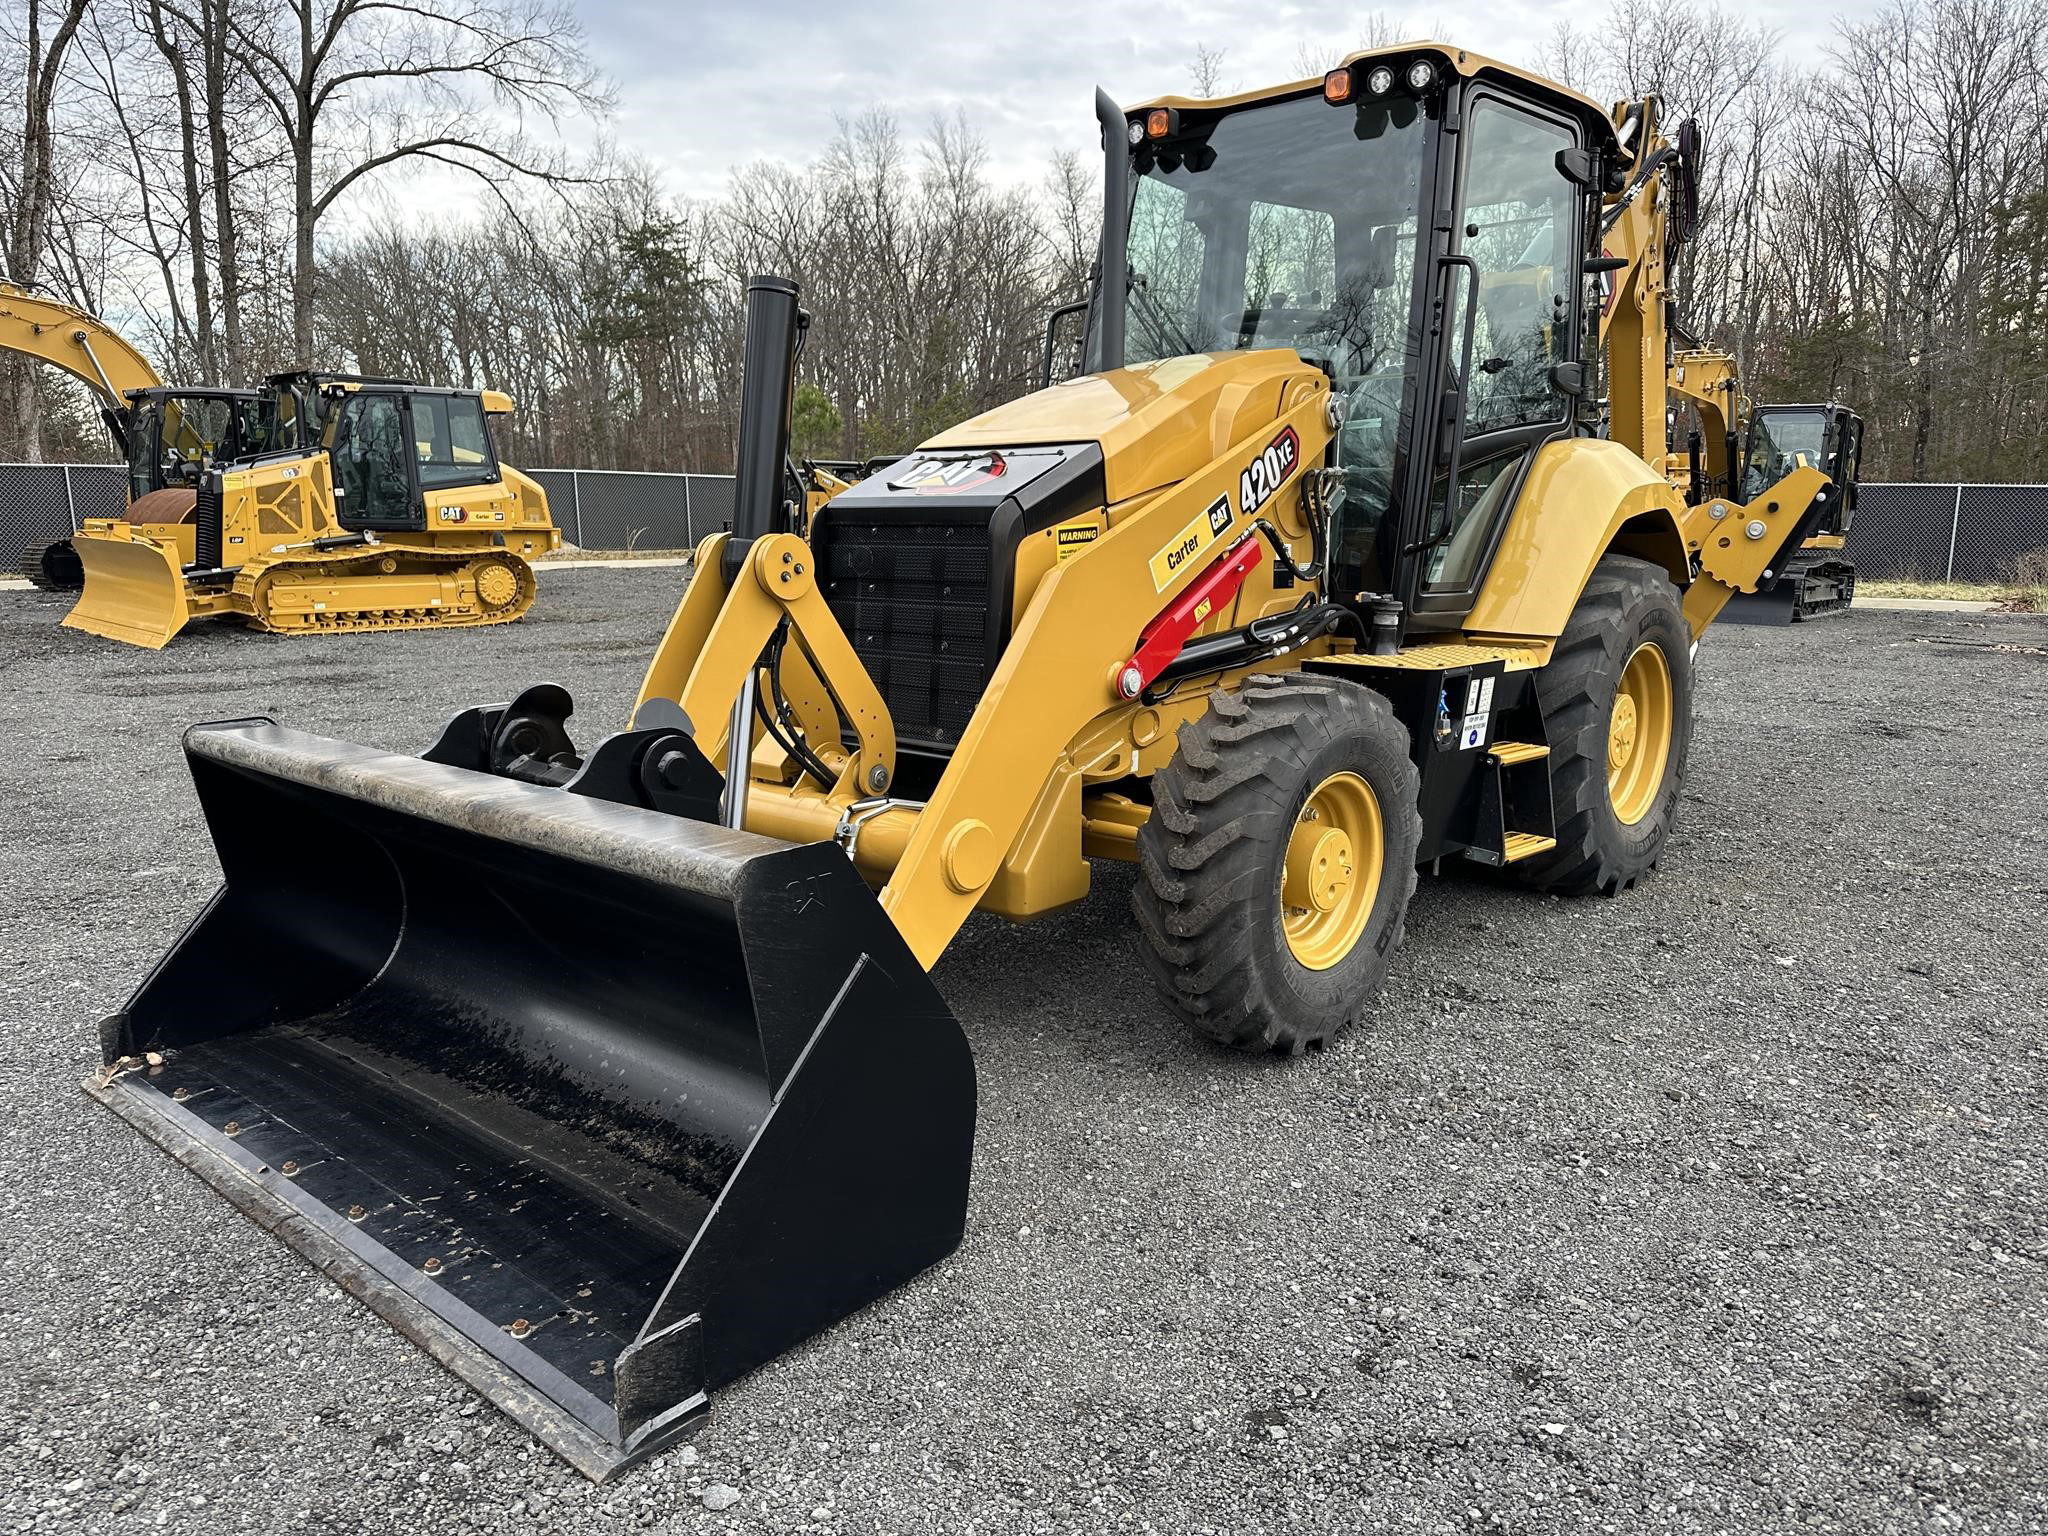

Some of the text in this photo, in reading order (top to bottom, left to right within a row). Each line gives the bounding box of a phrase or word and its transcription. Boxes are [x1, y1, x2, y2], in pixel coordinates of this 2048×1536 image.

[893, 457, 993, 488] CAT
[440, 507, 462, 521] CAT
[1060, 530, 1097, 542] WARNING
[1167, 502, 1229, 570] Carter CAT
